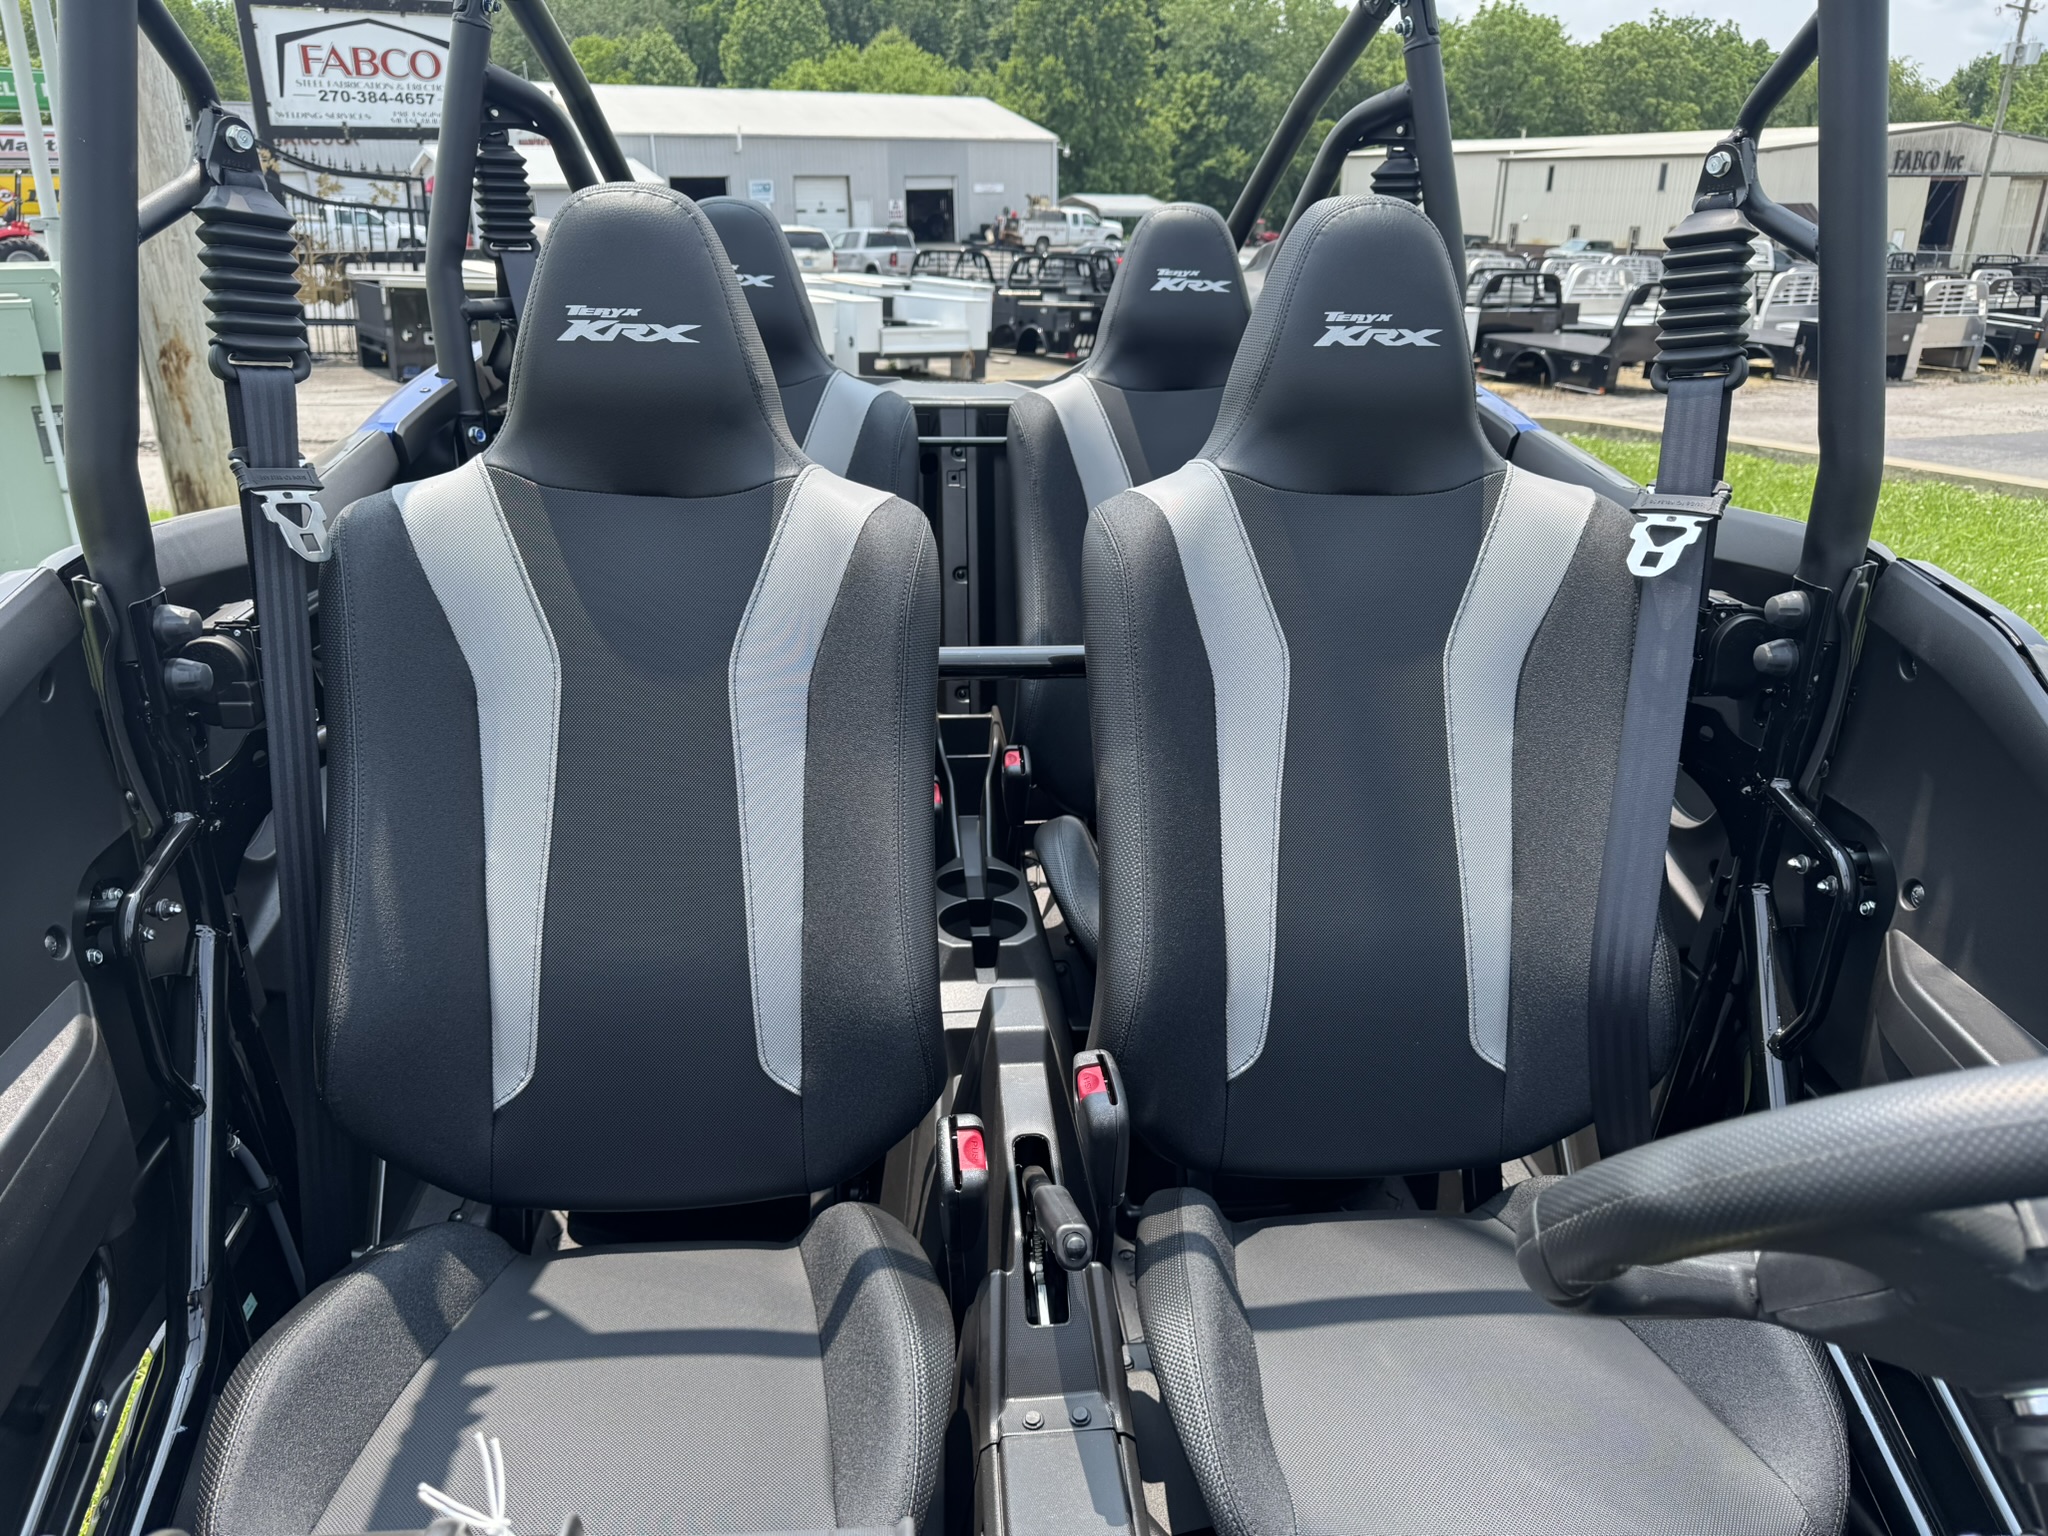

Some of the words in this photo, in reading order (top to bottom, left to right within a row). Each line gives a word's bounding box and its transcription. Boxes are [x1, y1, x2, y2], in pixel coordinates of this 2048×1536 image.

[298, 42, 442, 80] FABCO
[327, 81, 394, 90] FABRICATION
[318, 90, 435, 105] 270-384-4657
[1893, 149, 1941, 171] FABCO
[1943, 149, 1965, 171] Inc
[1150, 277, 1232, 293] KRX
[556, 319, 702, 344] KRX
[1312, 325, 1443, 347] KRX
